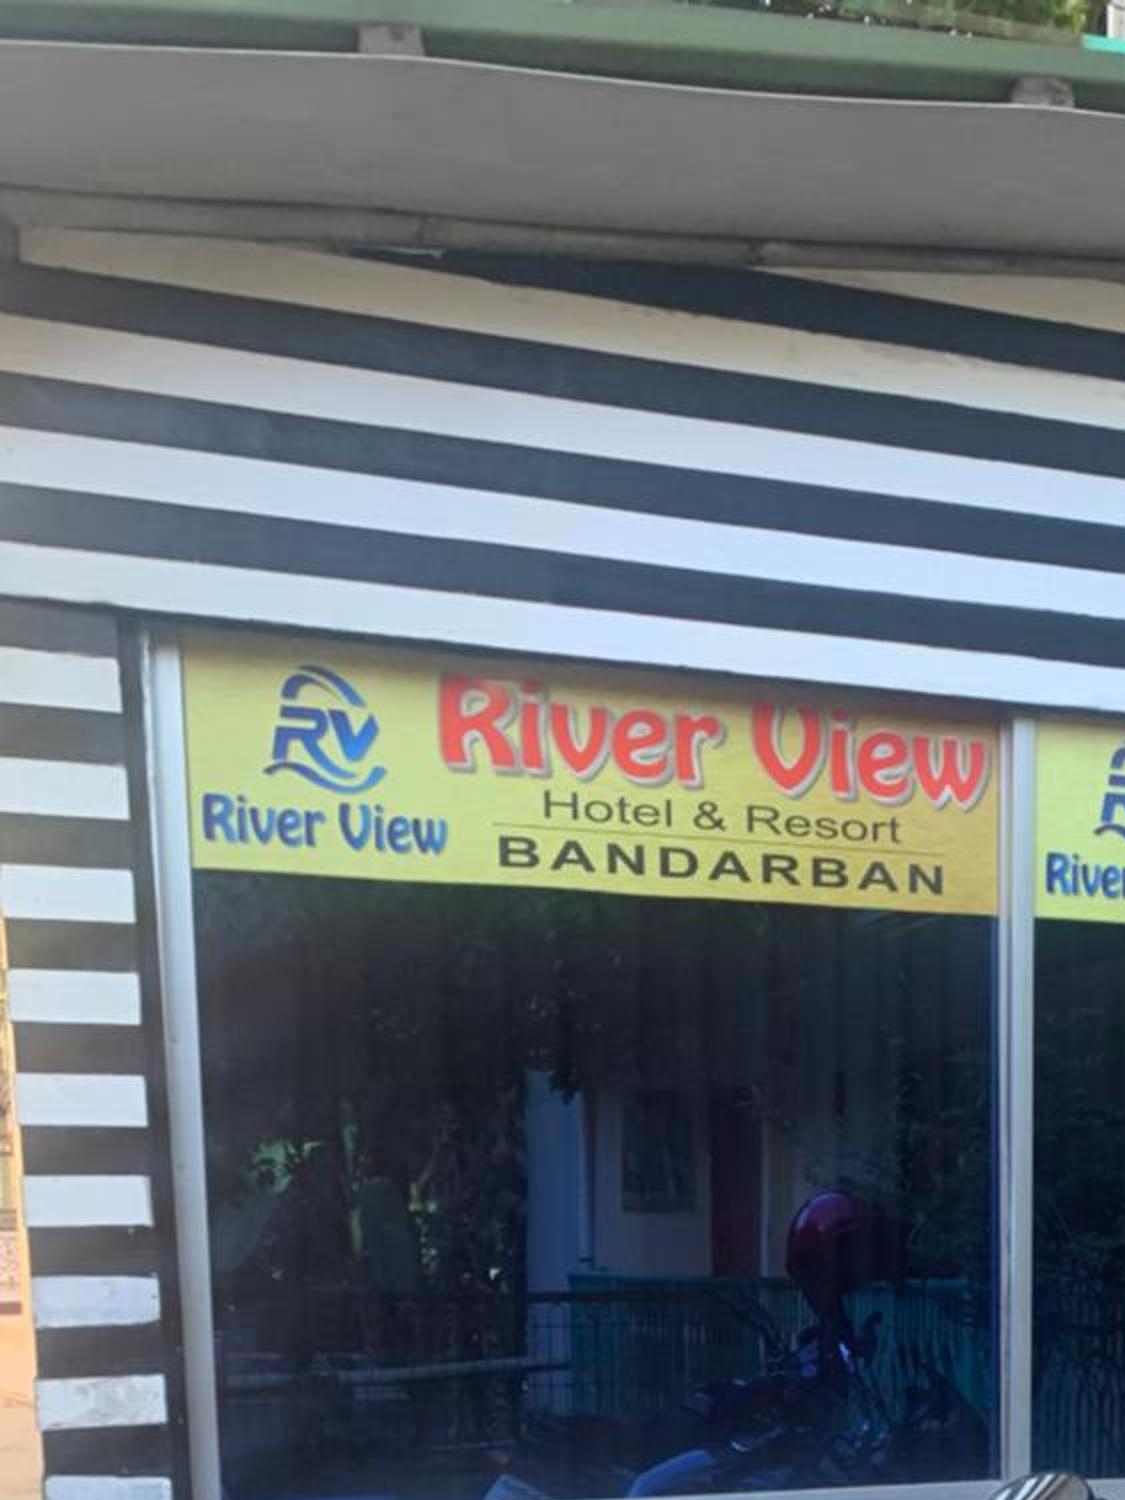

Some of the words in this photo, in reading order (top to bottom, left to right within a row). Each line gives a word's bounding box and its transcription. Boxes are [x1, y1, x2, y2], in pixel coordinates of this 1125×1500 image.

[439, 673, 723, 789] River
[753, 702, 992, 811] View
[202, 792, 325, 849] River
[339, 804, 447, 855] View
[543, 789, 674, 830] Hotel
[691, 797, 728, 833] &
[747, 804, 902, 845] Resort
[498, 835, 944, 895] BANDARBAN
